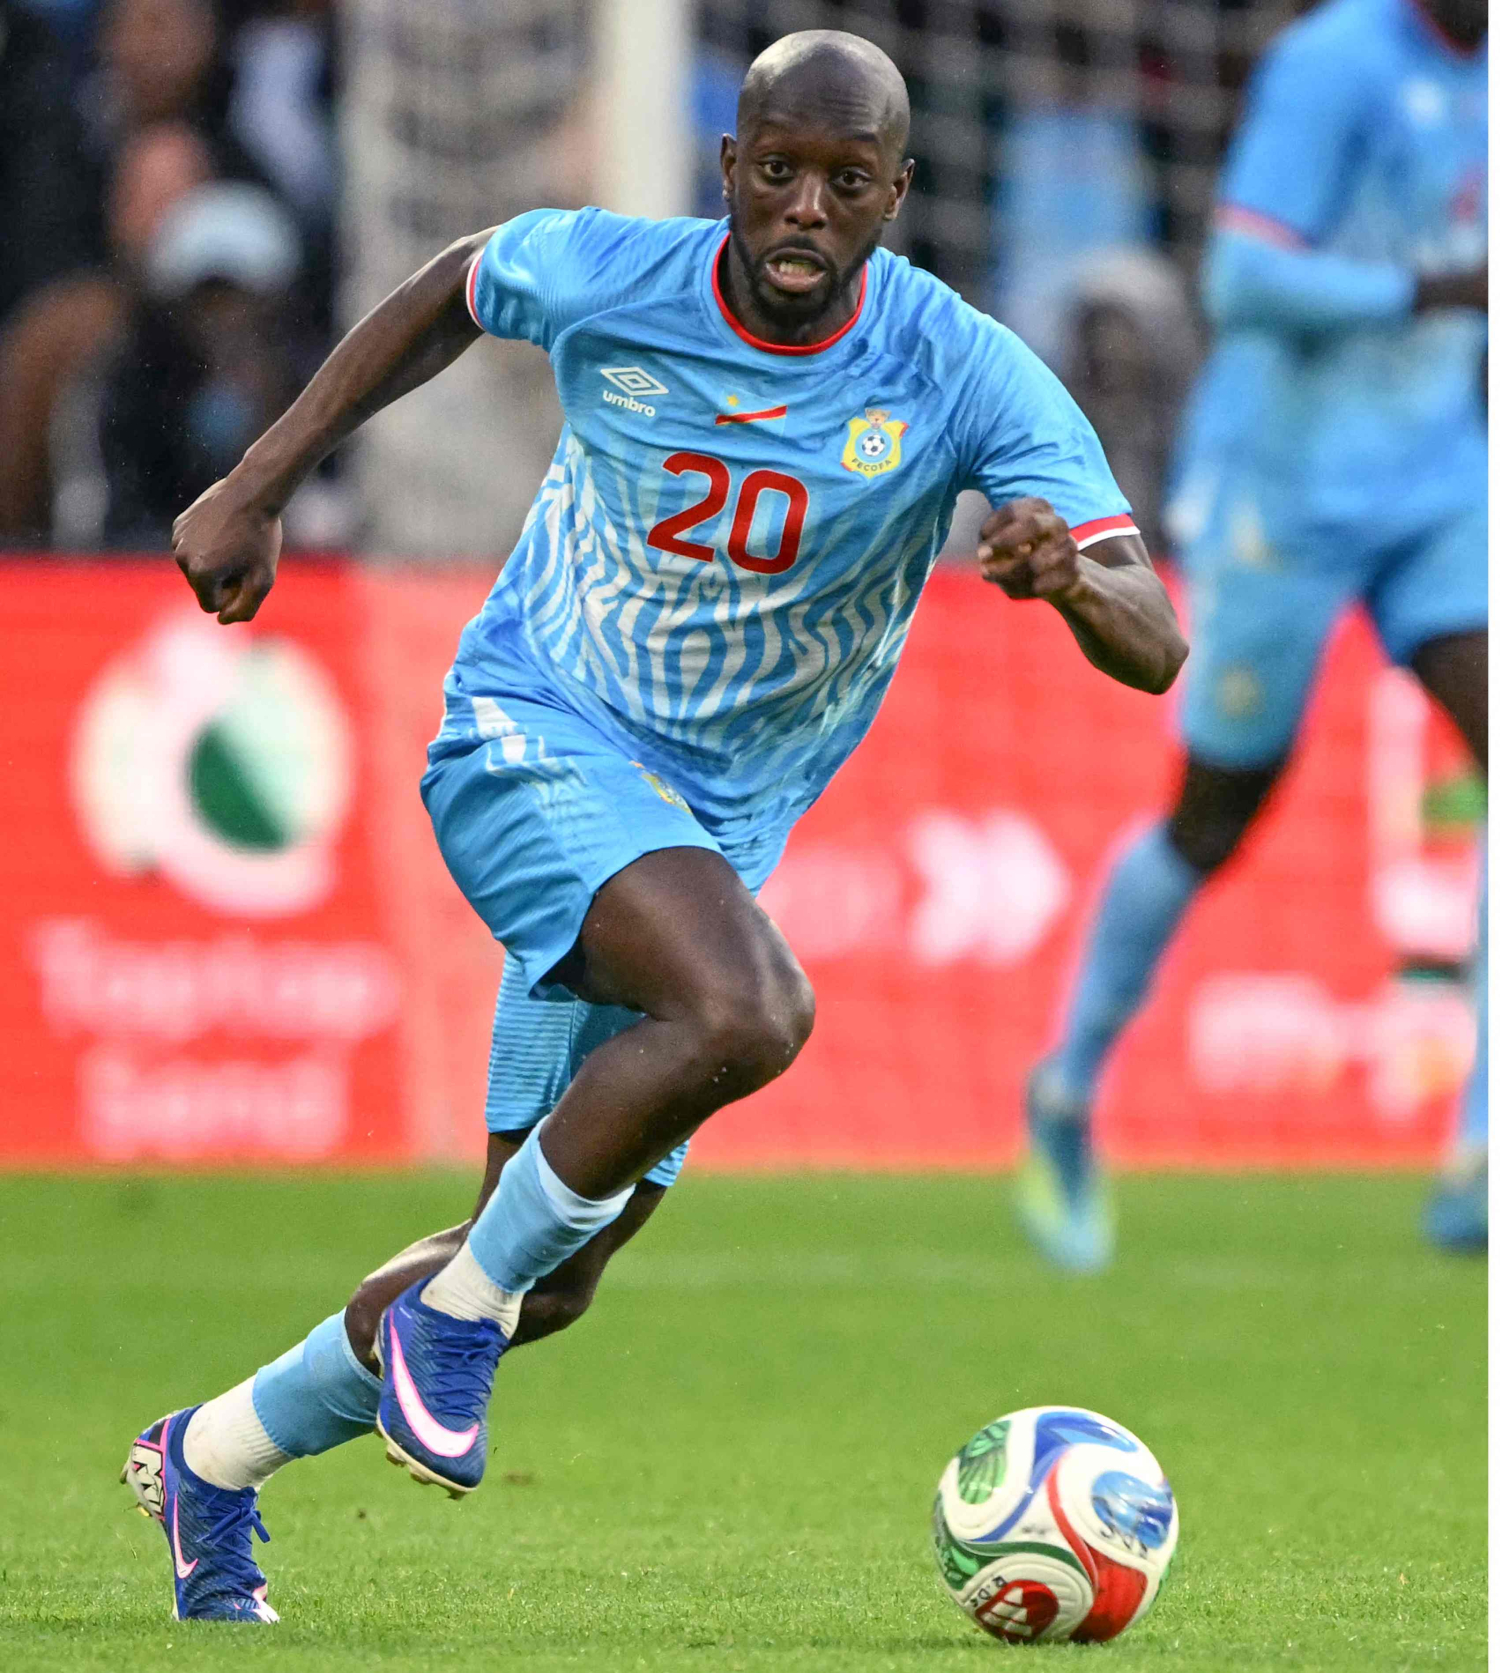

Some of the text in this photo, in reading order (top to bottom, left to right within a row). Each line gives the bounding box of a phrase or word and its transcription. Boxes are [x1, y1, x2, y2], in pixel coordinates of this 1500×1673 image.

[603, 390, 656, 417] umbro
[851, 458, 892, 471] FECOFA
[647, 451, 809, 574] 20
